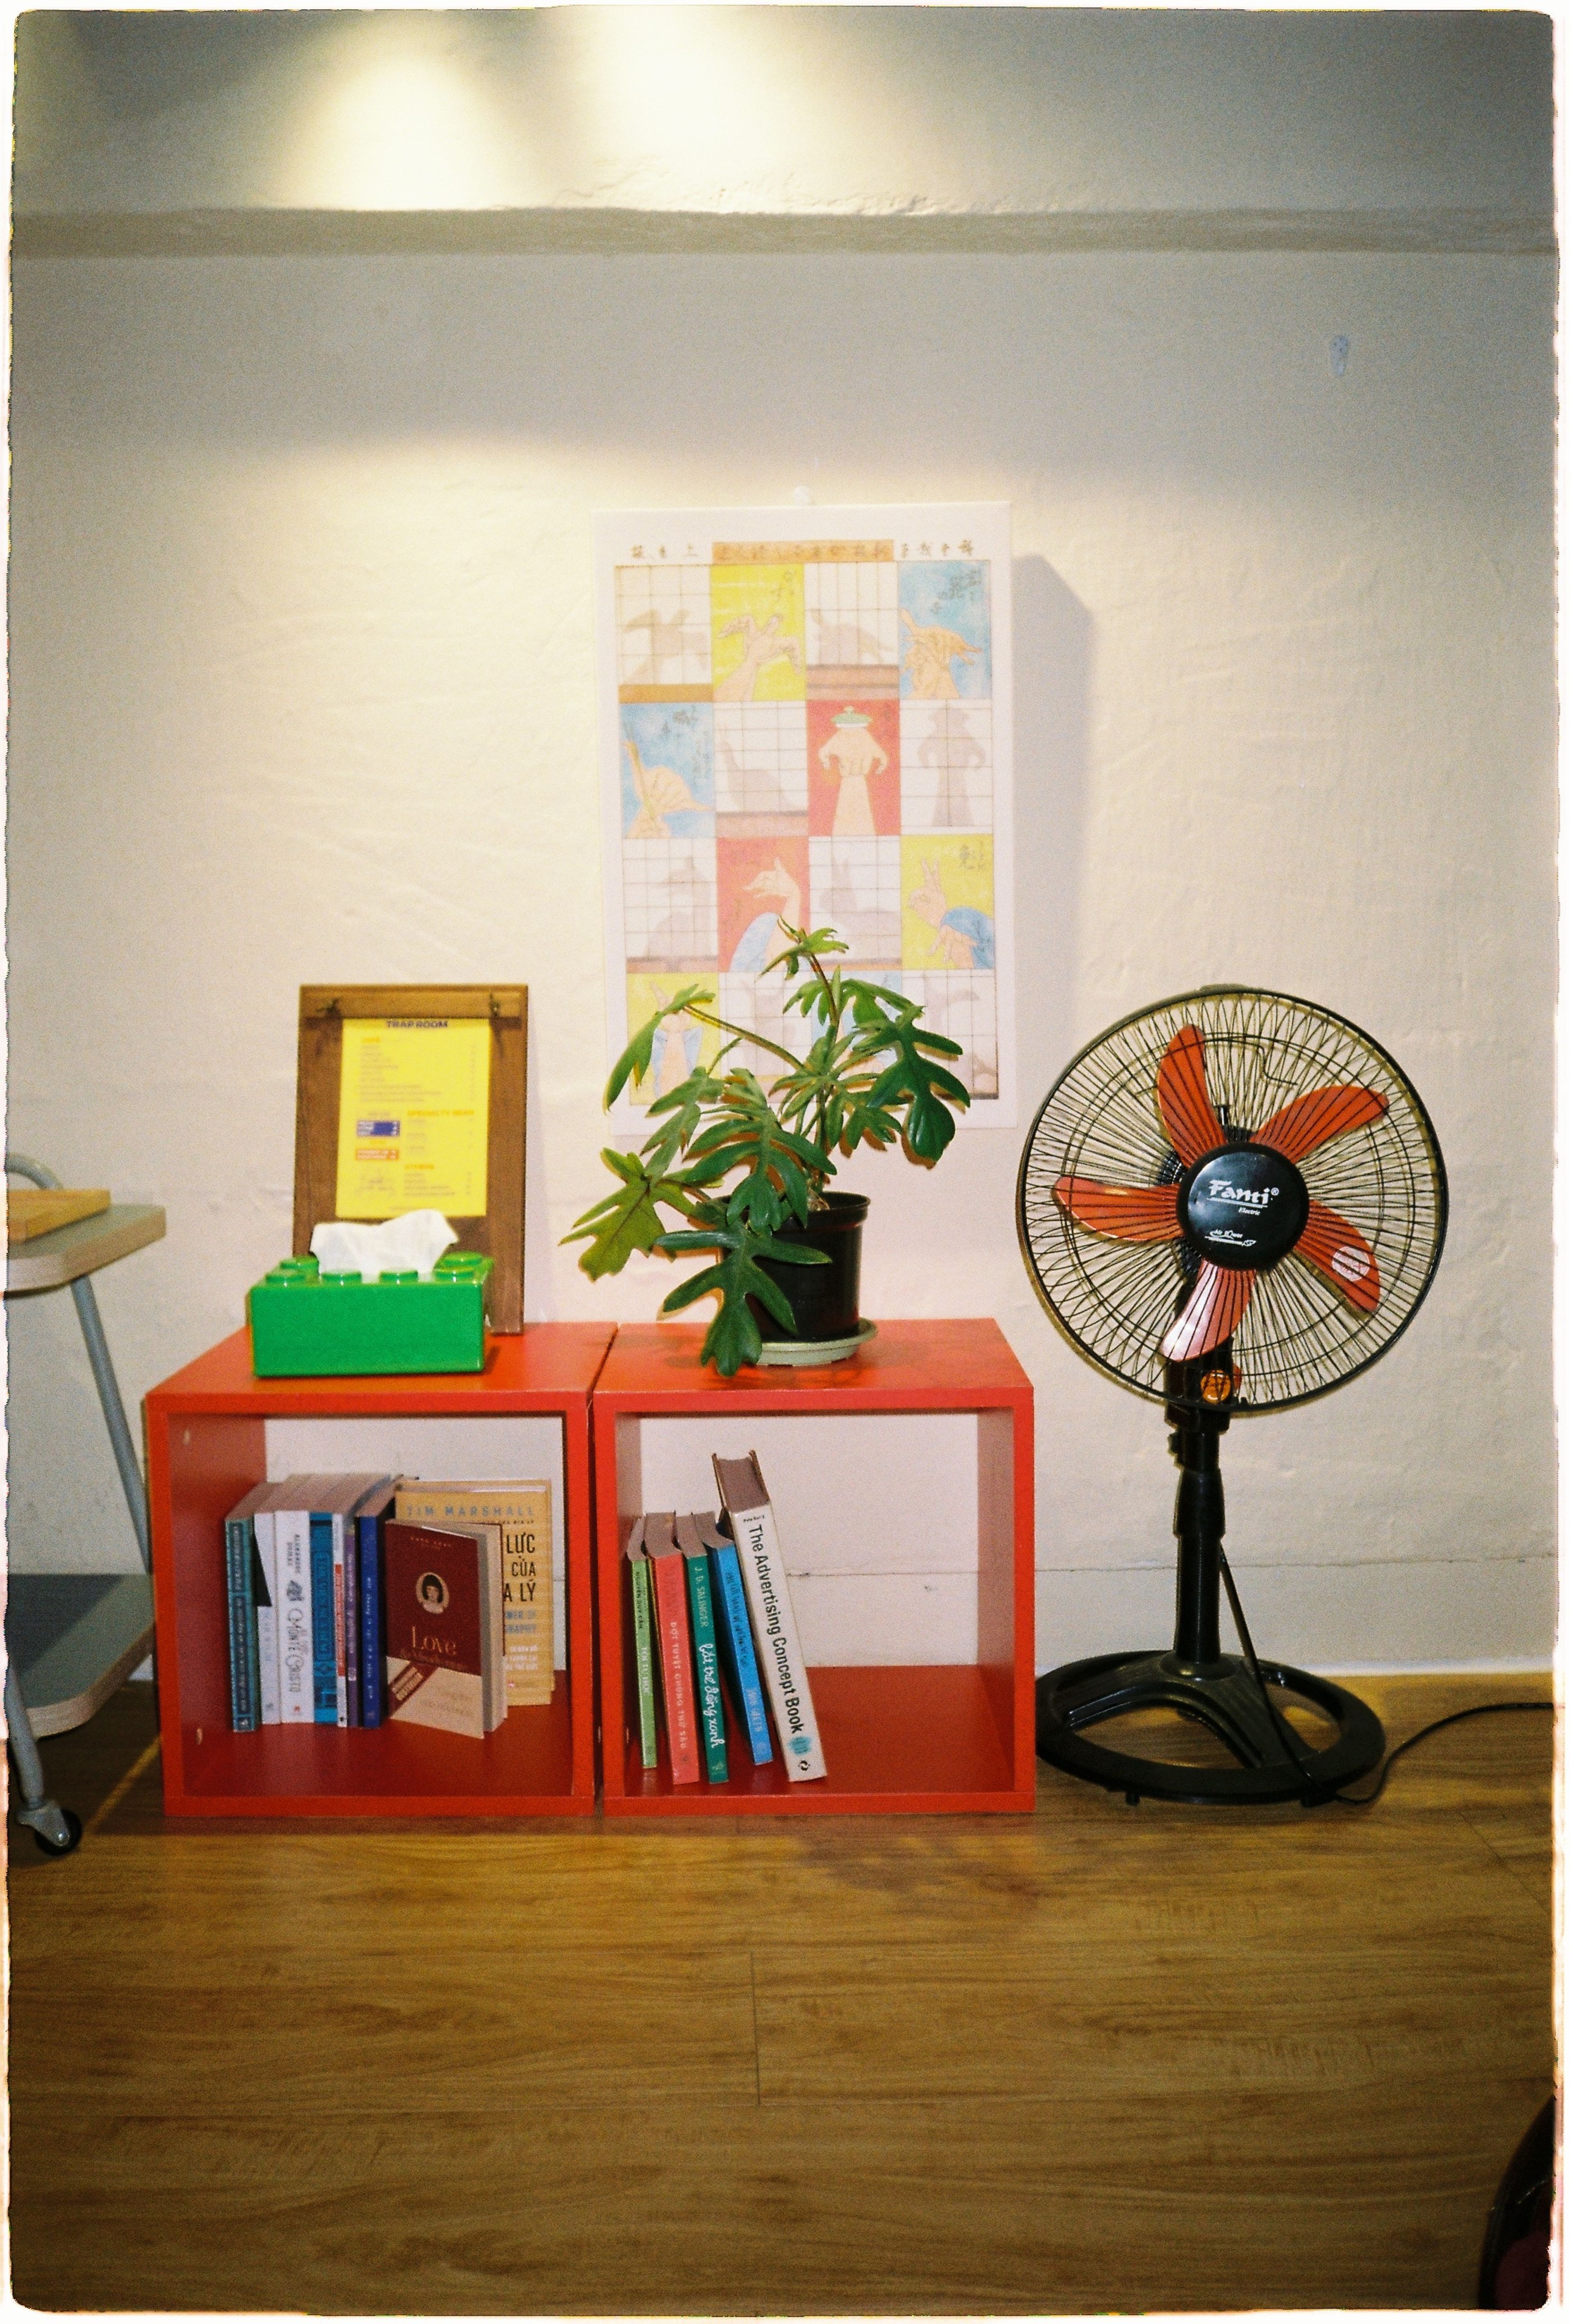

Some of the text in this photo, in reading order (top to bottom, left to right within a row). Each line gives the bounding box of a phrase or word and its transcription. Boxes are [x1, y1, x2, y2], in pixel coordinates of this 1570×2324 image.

[1238, 1207, 1260, 1216] Electric
[444, 1505, 534, 1516] MARSHALL
[511, 1559, 536, 1577] CỦA
[520, 1578, 536, 1602] LÝ
[696, 1586, 709, 1627] SALINGER
[411, 1626, 457, 1656] Love
[749, 1524, 804, 1734] The Advertising Concept Book
[708, 1718, 726, 1748] xanh
